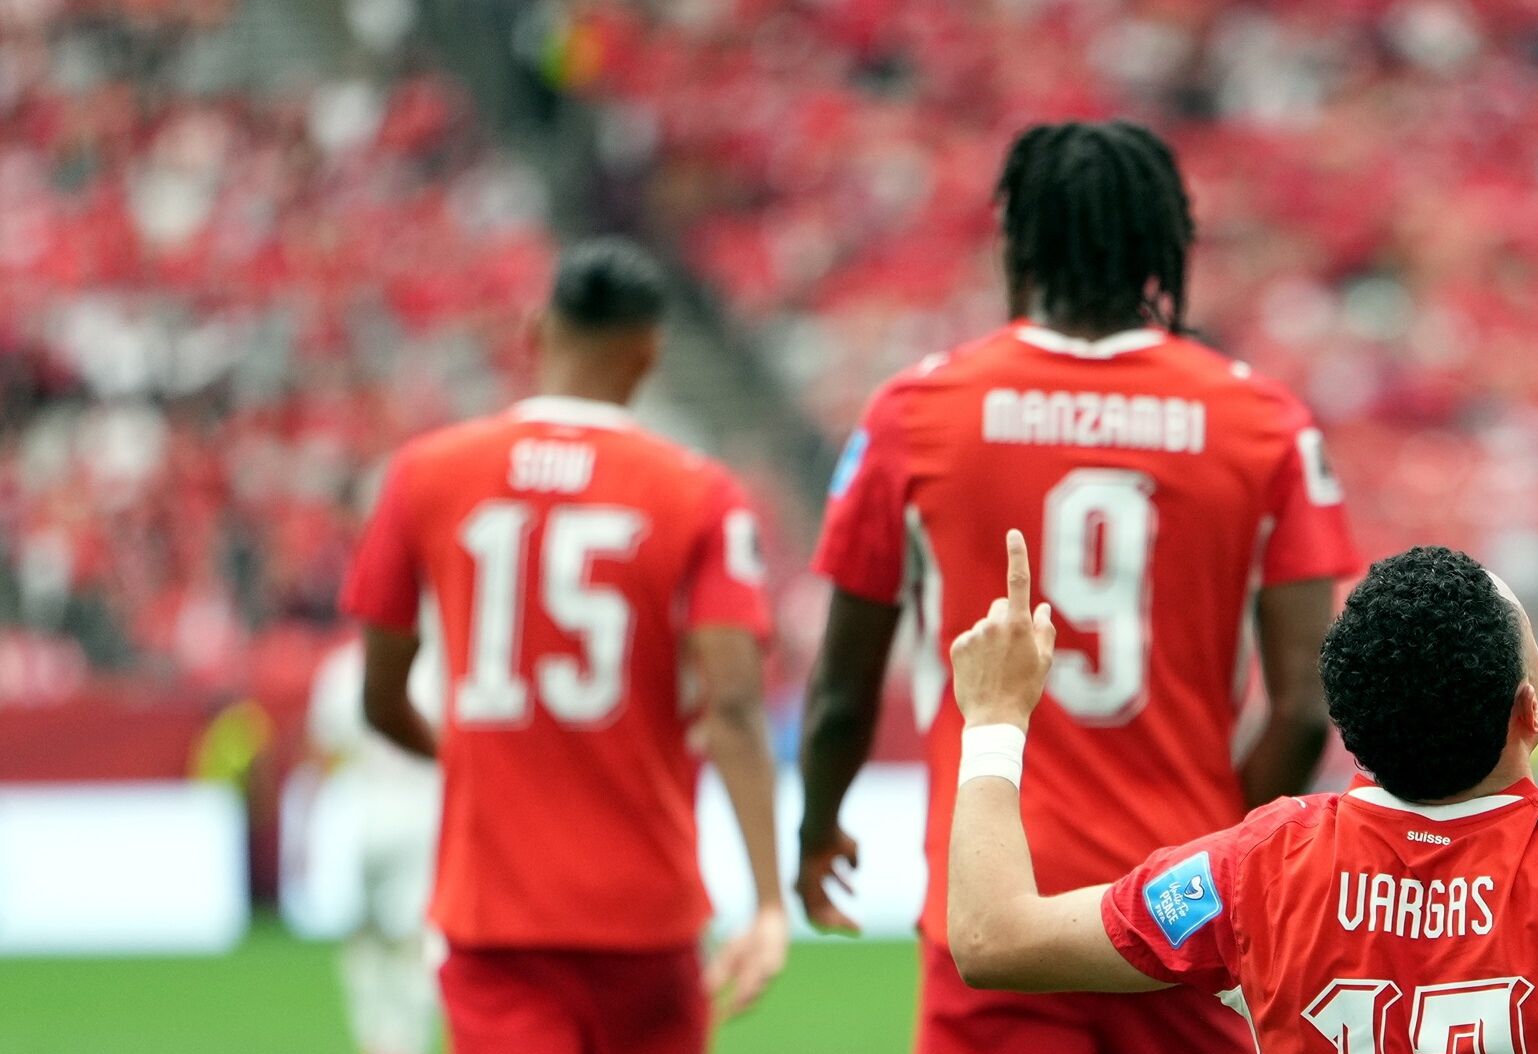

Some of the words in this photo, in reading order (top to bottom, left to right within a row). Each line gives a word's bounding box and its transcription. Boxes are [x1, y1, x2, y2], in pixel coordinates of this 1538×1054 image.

[982, 388, 1206, 454] MANZAMBI
[453, 498, 648, 728] 15
[1040, 468, 1157, 728] 9
[1407, 831, 1451, 846] suisse
[1159, 890, 1179, 925] PEACE
[1337, 871, 1494, 939] VARGAS
